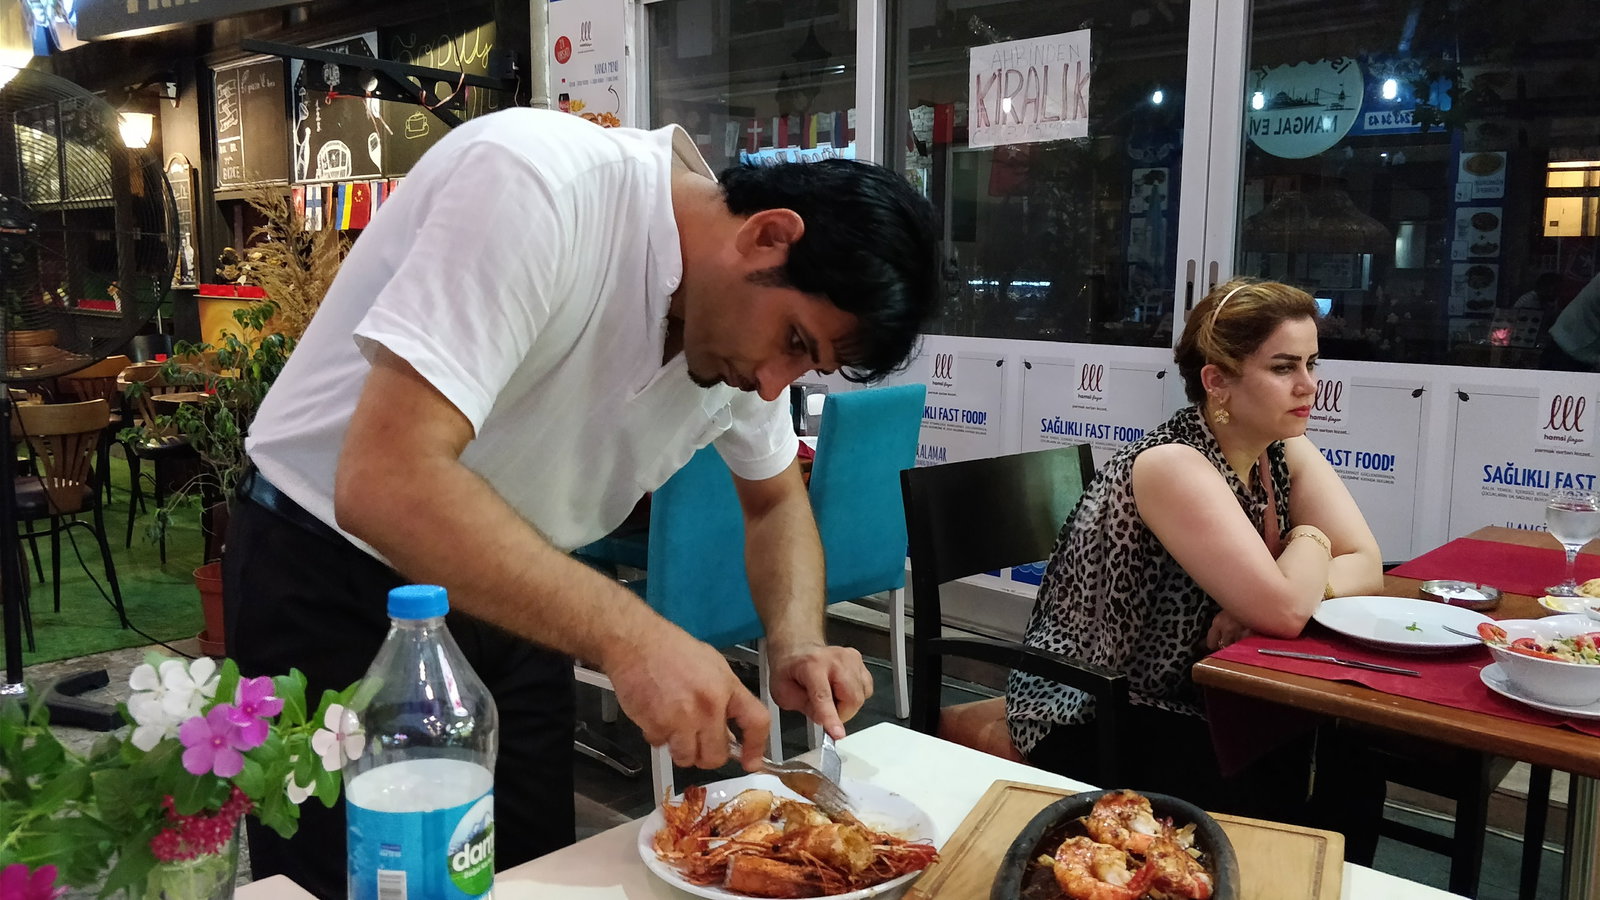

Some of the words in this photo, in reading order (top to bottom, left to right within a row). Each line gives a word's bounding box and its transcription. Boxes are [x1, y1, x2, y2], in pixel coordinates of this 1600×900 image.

[939, 407, 960, 422] FAST
[961, 410, 987, 426] FOOD!
[1041, 416, 1083, 437] SAĞLIKLI
[1085, 423, 1112, 440] FAST
[1543, 433, 1566, 442] hamsi
[1355, 451, 1395, 472] FOOD!
[1482, 462, 1550, 489] SAĞLIKLI
